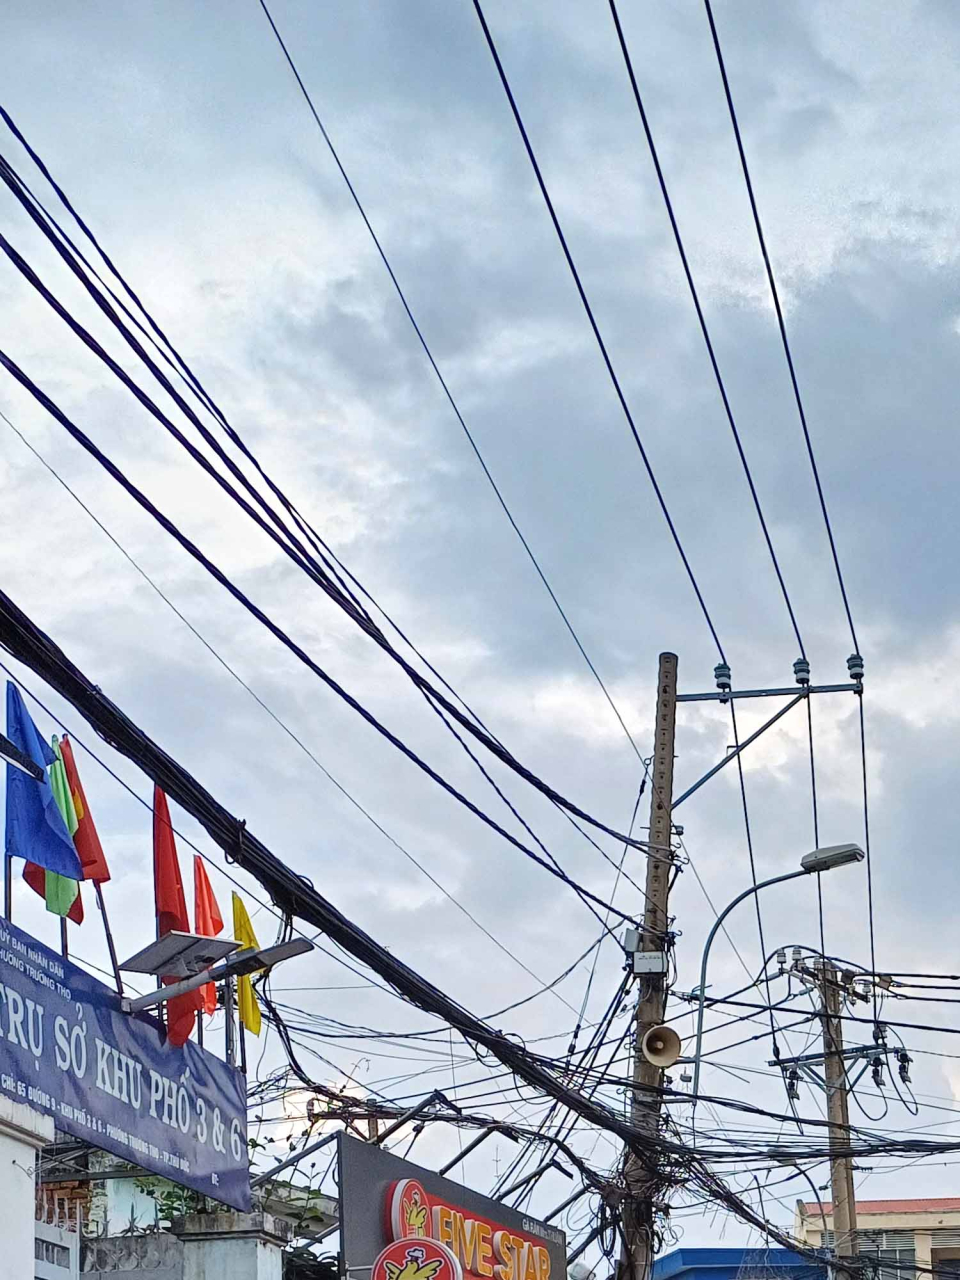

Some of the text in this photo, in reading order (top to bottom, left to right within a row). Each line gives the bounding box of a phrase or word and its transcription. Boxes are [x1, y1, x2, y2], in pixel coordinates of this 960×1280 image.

[12, 938, 27, 956] BAN
[28, 948, 48, 969] NHÂN
[49, 961, 64, 979] DÂN
[17, 1081, 27, 1097] 65
[54, 1002, 87, 1078] SỞ
[95, 1037, 142, 1109] KHU
[149, 1067, 190, 1133] PHỐ
[196, 1098, 207, 1143] 3
[213, 1107, 226, 1154] &
[230, 1117, 242, 1162] 6
[436, 1206, 493, 1277] FIVE
